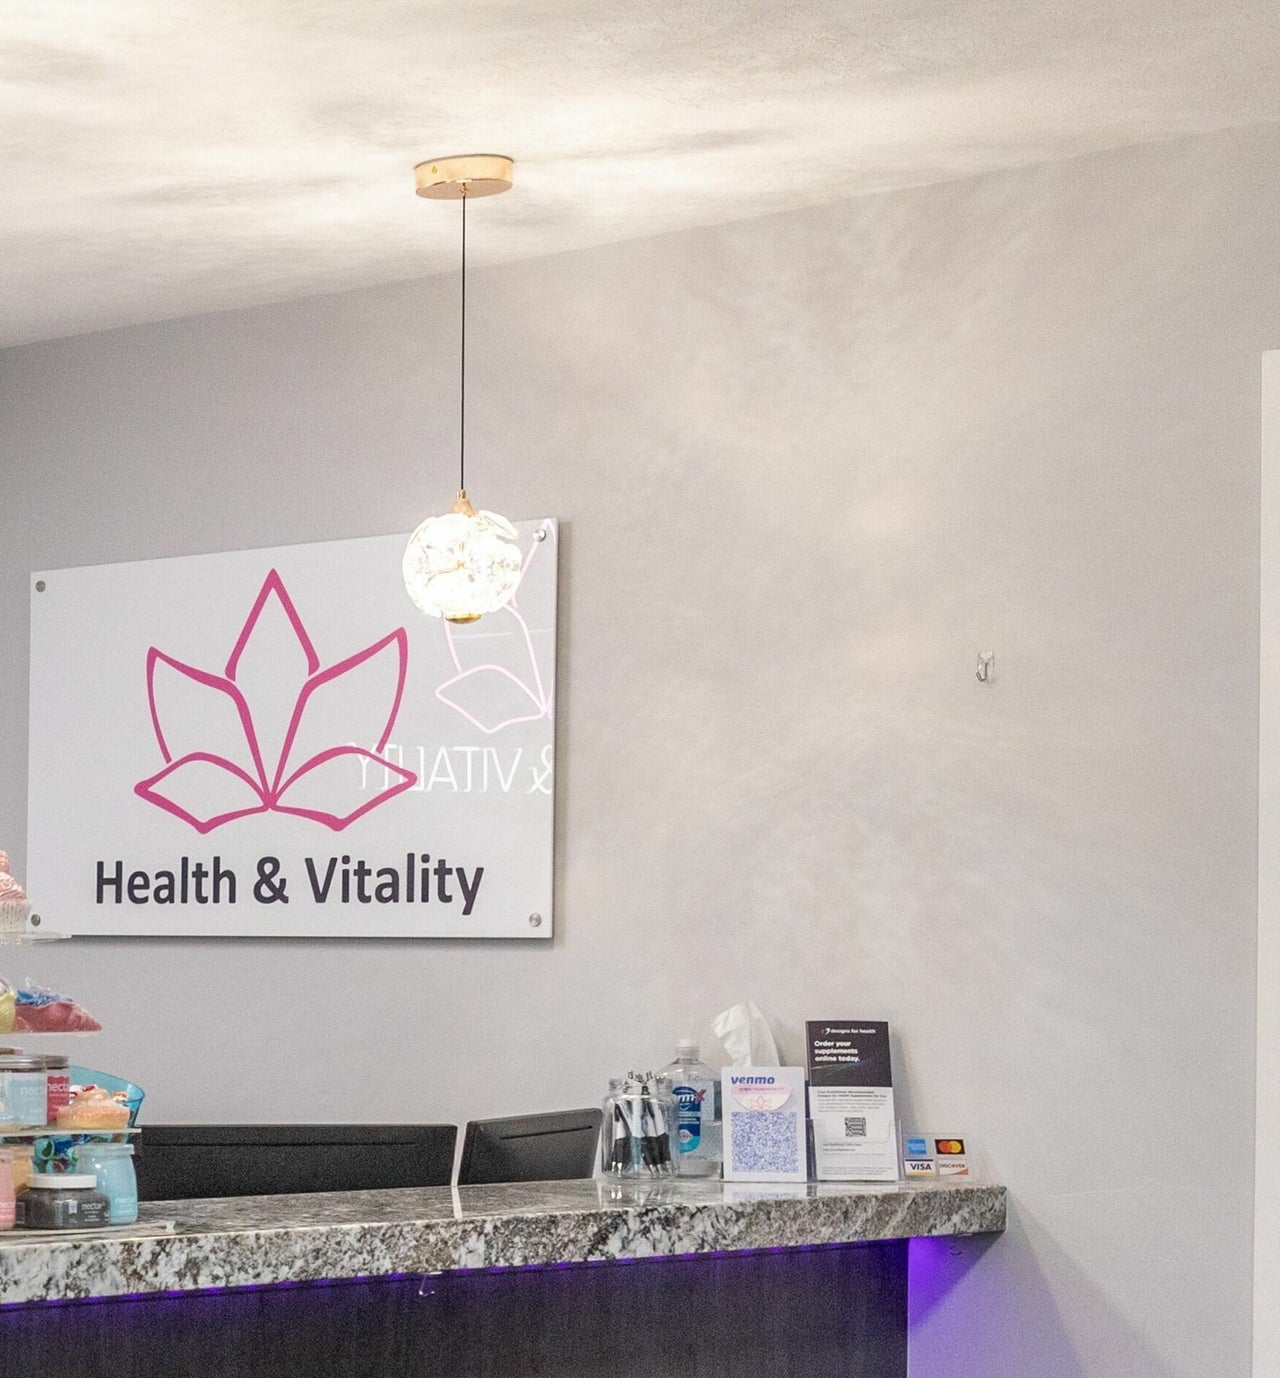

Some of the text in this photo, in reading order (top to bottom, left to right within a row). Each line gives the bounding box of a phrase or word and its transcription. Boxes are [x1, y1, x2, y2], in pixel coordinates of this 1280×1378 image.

[96, 852, 484, 916] Health & Vitality
[730, 1076, 775, 1085] venmo
